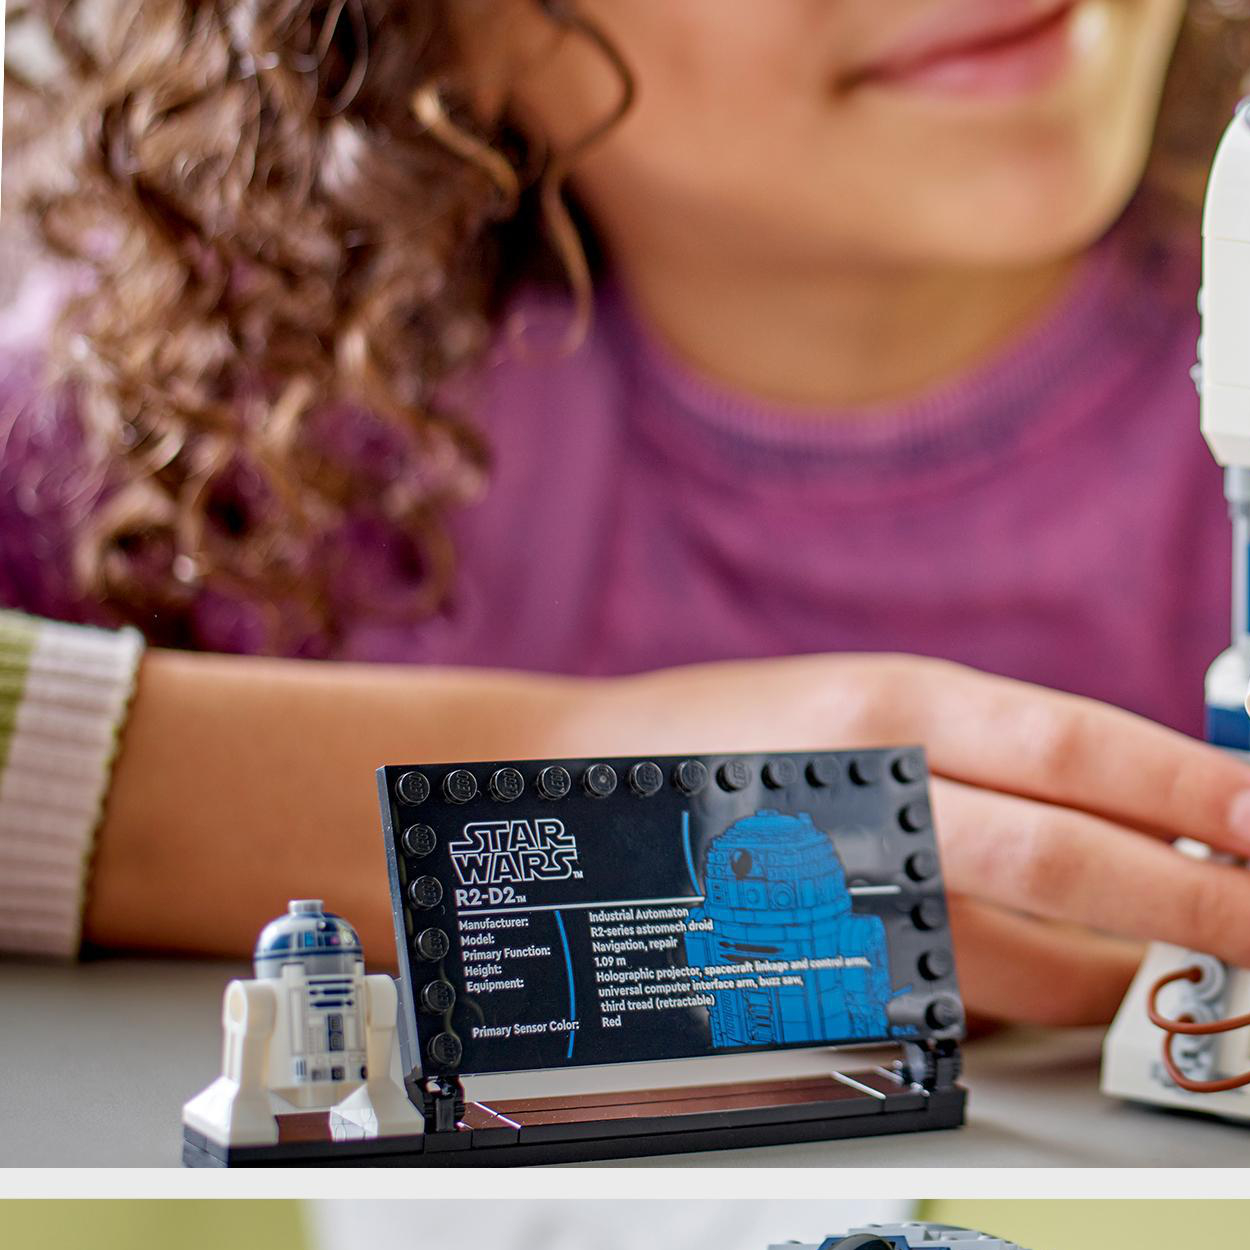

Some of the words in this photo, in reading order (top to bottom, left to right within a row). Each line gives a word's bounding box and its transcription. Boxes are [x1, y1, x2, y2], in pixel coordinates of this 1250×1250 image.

[449, 818, 576, 854] STAR
[589, 907, 634, 922] Industrial
[636, 907, 689, 920] Automaton
[459, 917, 529, 930] Manufacturer:
[591, 924, 634, 937] R2-series
[636, 920, 687, 934] astromech
[688, 919, 713, 931] droid
[460, 933, 495, 946] Model:
[592, 939, 648, 953] Navigation,
[649, 936, 678, 950] repair
[463, 949, 502, 961] Primary
[504, 945, 551, 958] Function:
[594, 956, 614, 967] 1.09
[616, 957, 626, 965] m
[464, 964, 502, 977] Height:
[596, 968, 654, 983] Holographic
[656, 966, 702, 981] projector,
[705, 961, 753, 978] spacecraft
[790, 958, 809, 969] and
[466, 978, 524, 993] Equipment:
[598, 983, 642, 997] universal
[644, 982, 690, 994] computer
[692, 979, 734, 990] interface
[736, 978, 758, 989] arm,
[759, 976, 781, 986] buzz
[782, 976, 804, 986] saw,
[600, 999, 625, 1012] third
[627, 997, 653, 1010] tread
[655, 994, 715, 1010] (retractable)
[472, 1026, 512, 1038] Primary
[513, 1023, 547, 1034] Sensor
[549, 1018, 580, 1031] Color:
[602, 1015, 622, 1027] Red
